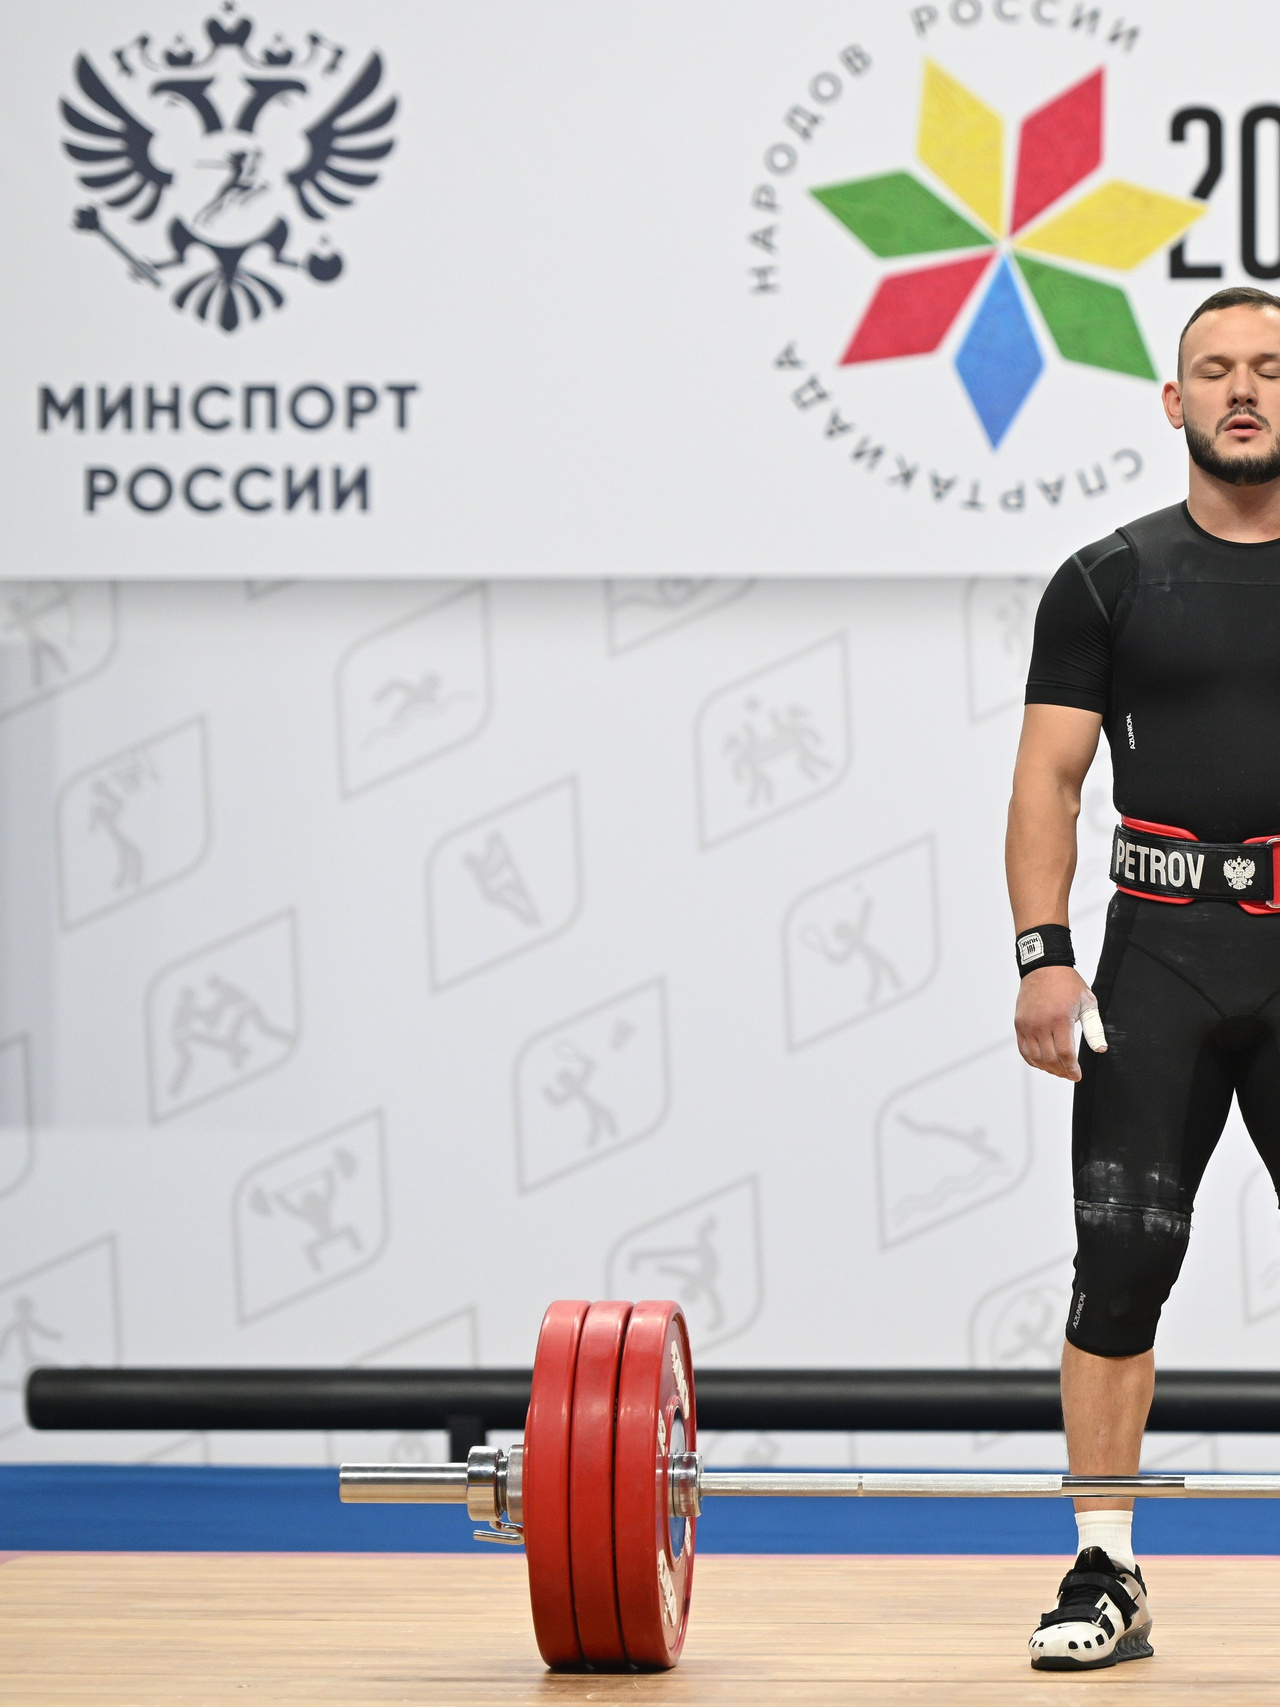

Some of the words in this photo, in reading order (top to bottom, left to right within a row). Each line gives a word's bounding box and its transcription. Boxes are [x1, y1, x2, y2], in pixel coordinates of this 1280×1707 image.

[910, 0, 1142, 53] РОССИИ
[748, 44, 872, 295] НАРОДОВ
[37, 383, 420, 433] МИНСПОРТ
[774, 343, 1145, 513] СПАРТАКИАДА
[84, 465, 371, 515] РОССИИ
[1115, 838, 1205, 890] PETROV
